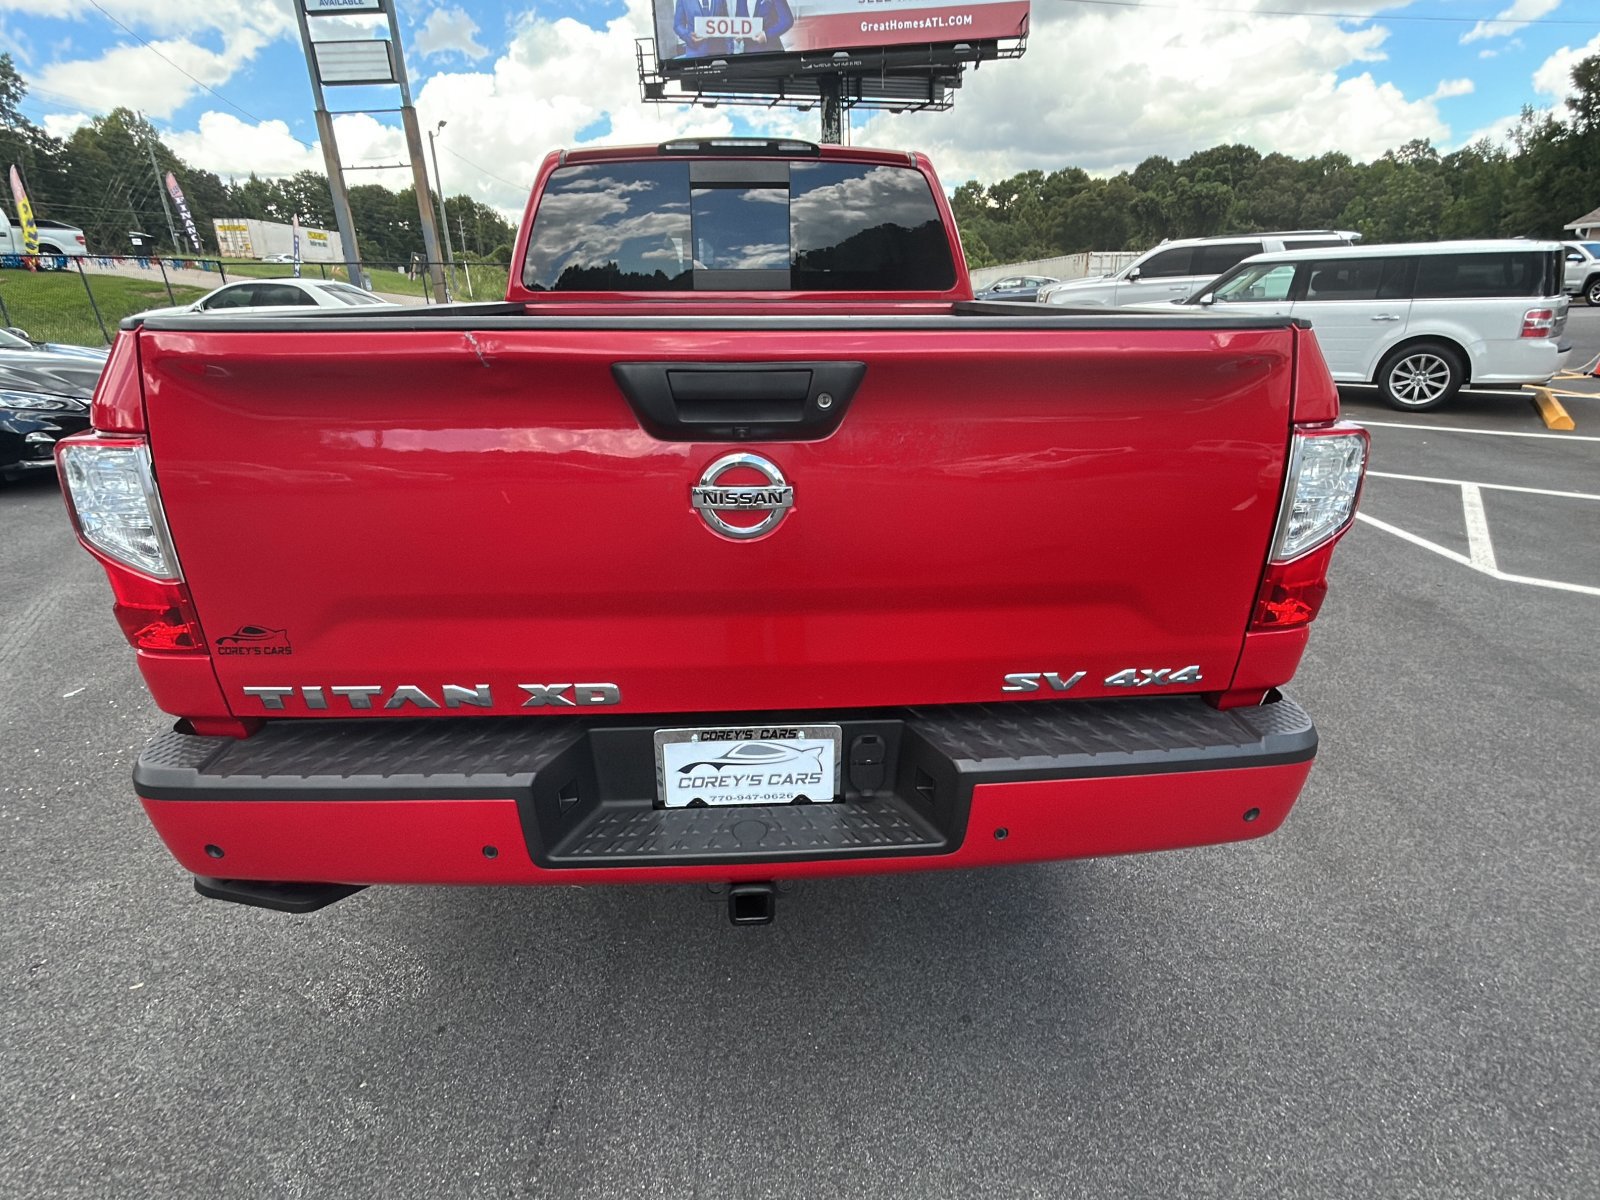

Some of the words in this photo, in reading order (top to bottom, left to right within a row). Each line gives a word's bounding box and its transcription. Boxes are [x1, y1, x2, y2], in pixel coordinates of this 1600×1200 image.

[706, 20, 752, 35] SOLD
[860, 15, 973, 32] GreatHomesATL.COM
[703, 492, 783, 505] NISSAN
[218, 646, 262, 656] COREY'S
[263, 646, 292, 655] CARS
[1001, 671, 1087, 693] SV
[243, 683, 494, 709] TITAN
[517, 682, 622, 707] XD
[701, 730, 753, 742] COREY'S
[760, 729, 797, 740] CARS
[678, 774, 763, 789] COREY'S
[767, 772, 823, 787] CARS
[709, 793, 794, 802] 770-947-0626
